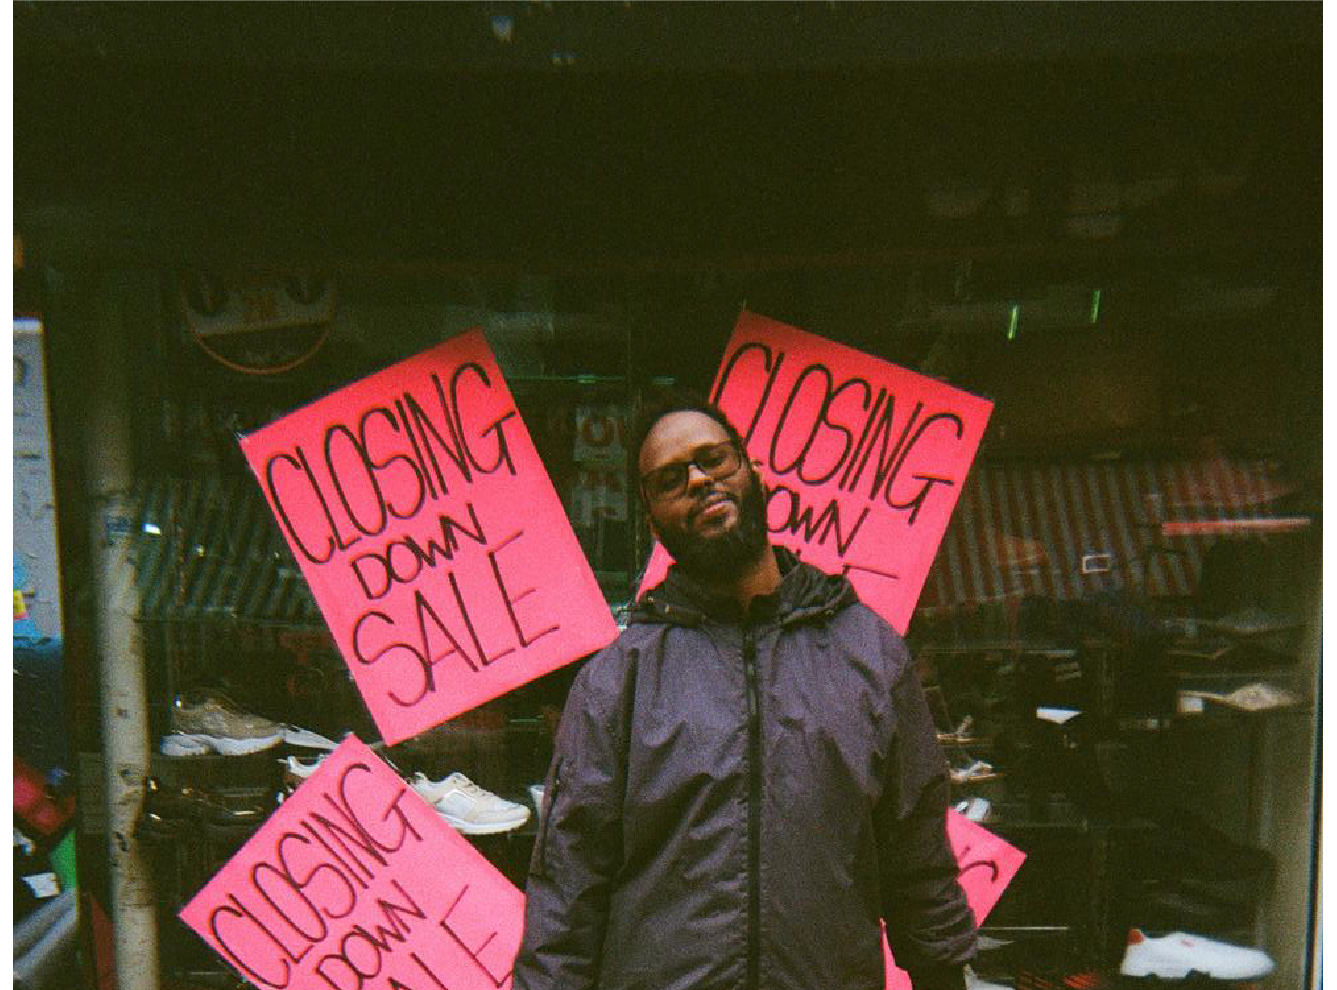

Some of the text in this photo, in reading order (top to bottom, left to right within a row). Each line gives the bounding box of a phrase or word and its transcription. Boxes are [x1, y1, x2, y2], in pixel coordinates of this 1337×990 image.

[265, 362, 517, 565] CLOSING
[713, 342, 963, 527] CLOSING
[765, 486, 869, 557] OWN
[350, 502, 487, 600] DOWN
[353, 531, 561, 707] SALE
[210, 763, 423, 990] CLOSING
